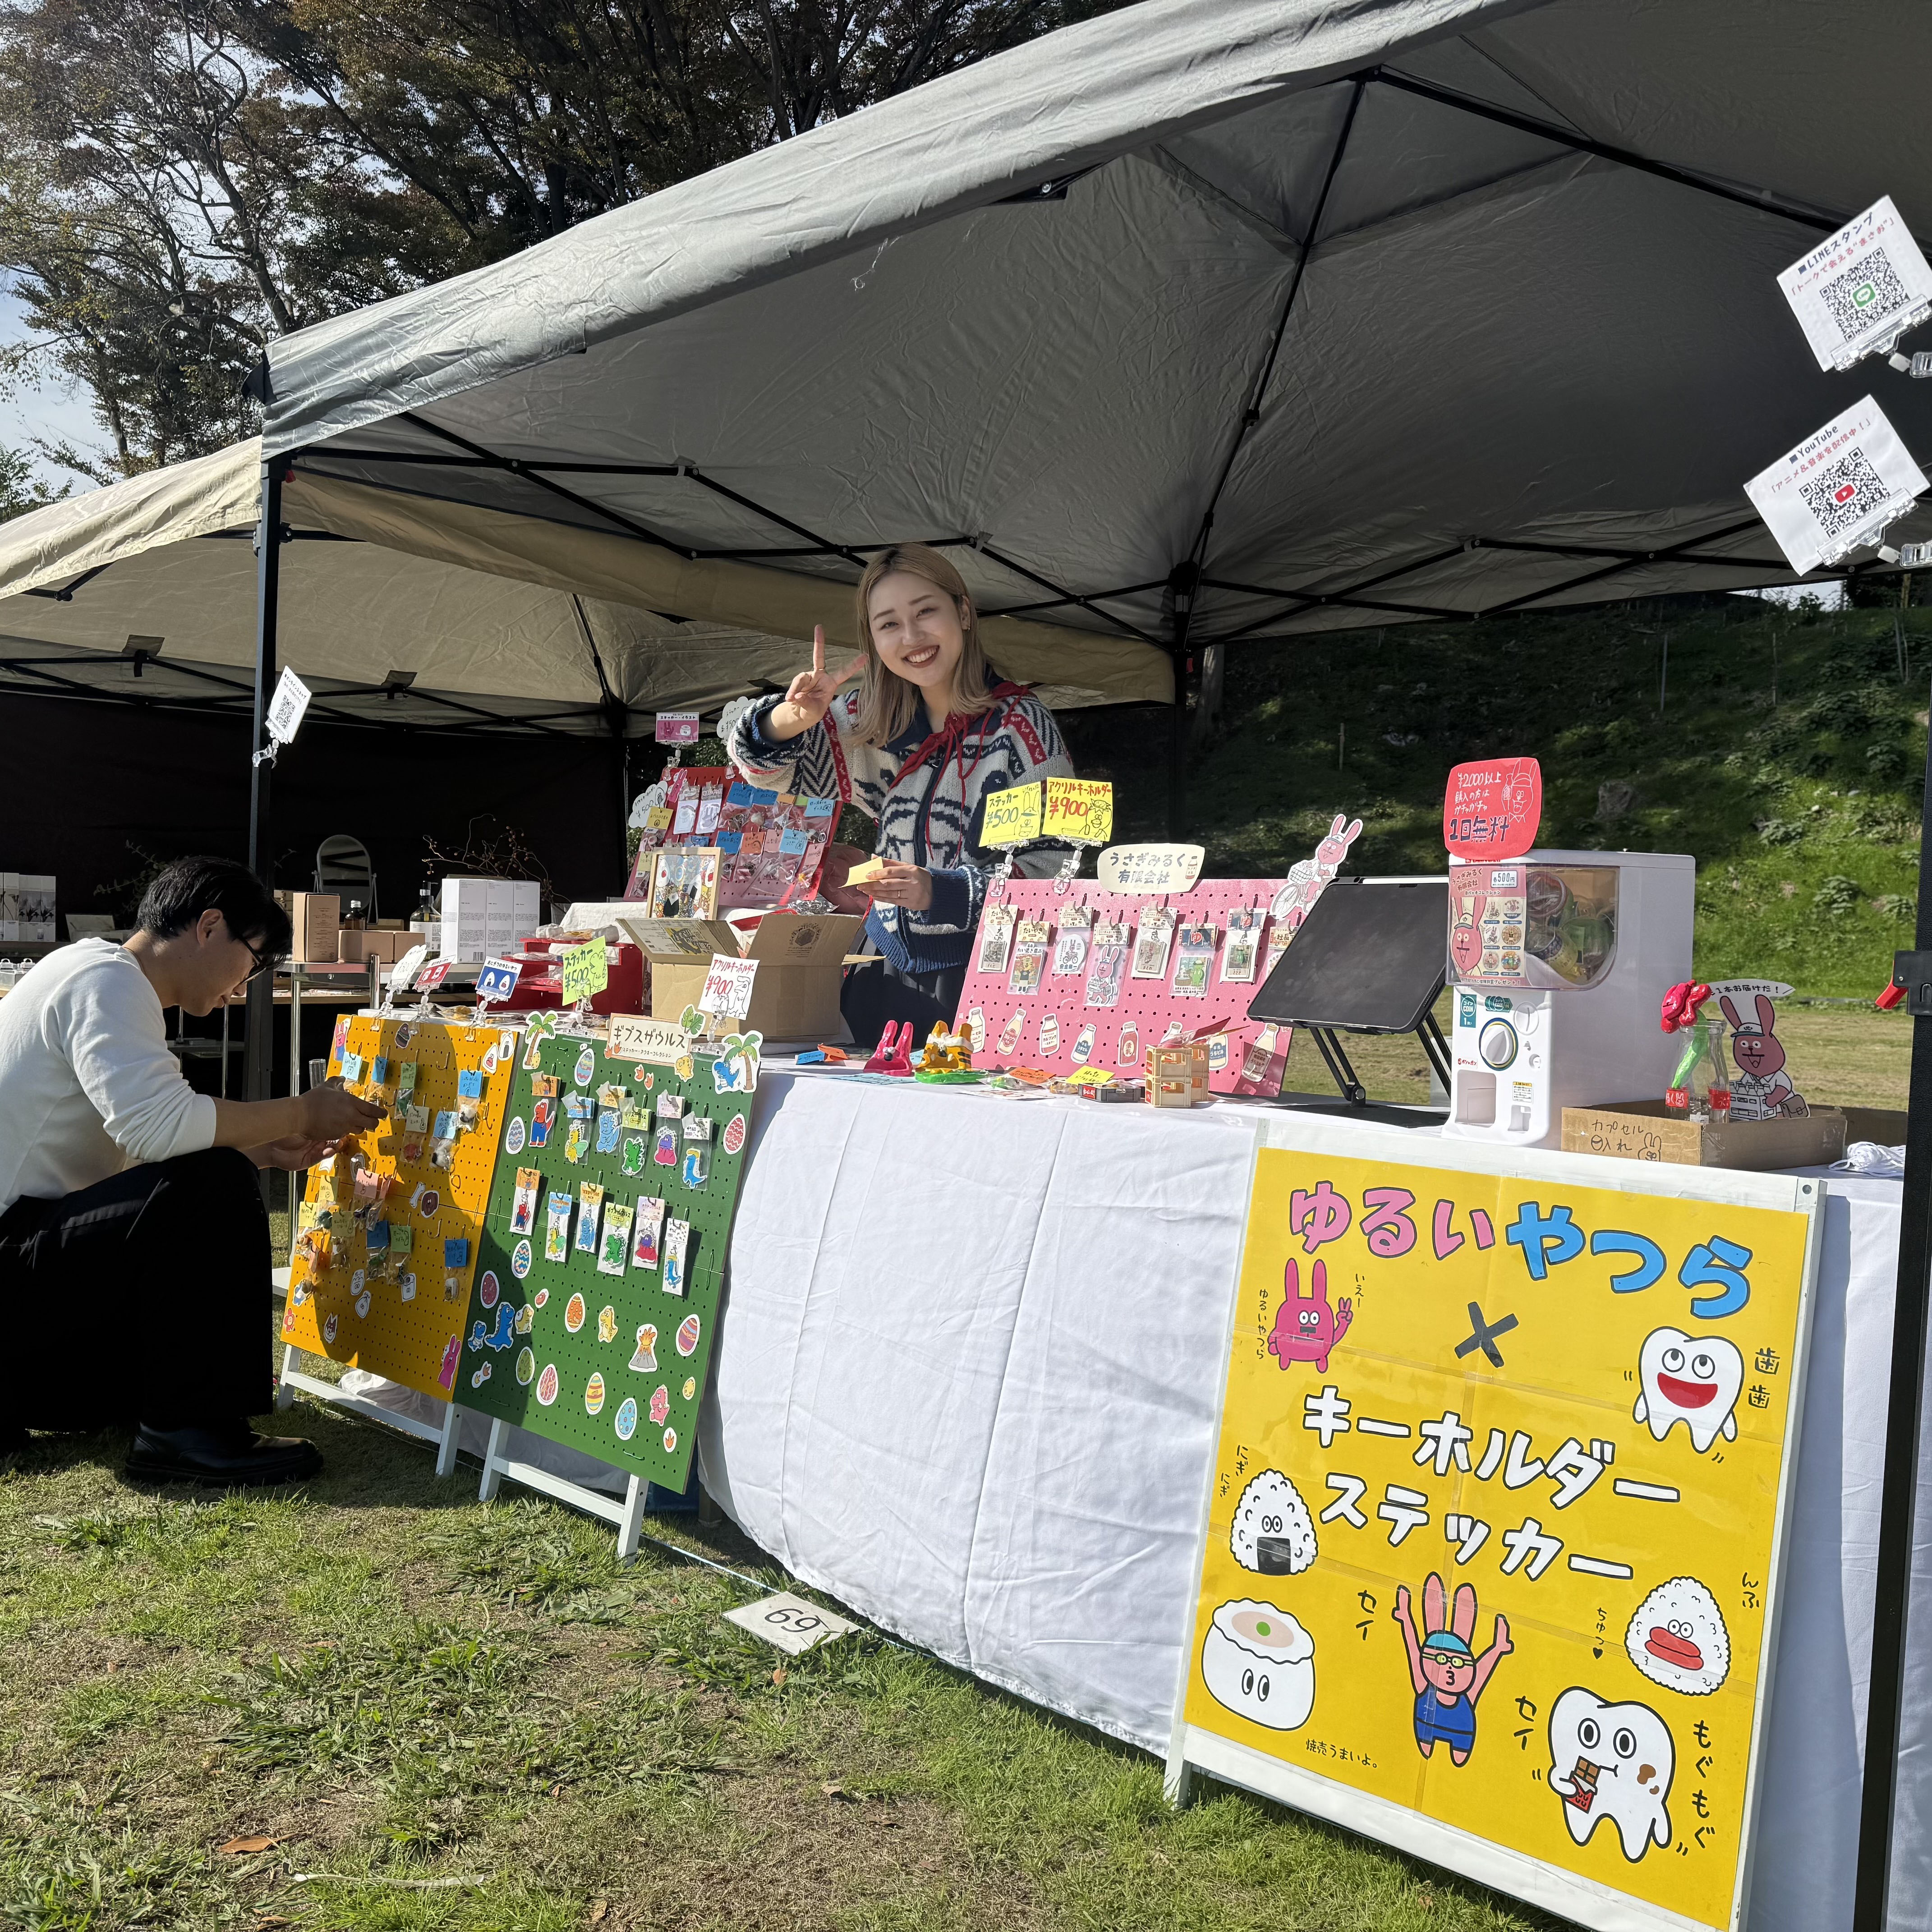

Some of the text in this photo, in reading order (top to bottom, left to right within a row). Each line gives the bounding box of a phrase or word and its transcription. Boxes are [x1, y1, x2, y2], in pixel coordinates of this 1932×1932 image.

[1798, 426, 1839, 457] YouTube
[989, 792, 1019, 808] ステッカー
[1049, 782, 1112, 797] アクリルキーホルダー
[985, 807, 1019, 829] ¥500
[1049, 796, 1088, 820] ¥900
[1454, 800, 1488, 815] ガチャガチャ
[1449, 815, 1510, 843] 1回無料
[1110, 852, 1185, 867] うさぎみるく
[1118, 869, 1170, 884] 有限会社
[1452, 867, 1483, 885] うさぎみるく
[1457, 879, 1479, 892] 有限会社
[565, 949, 593, 970] ステッカー
[565, 967, 589, 992] ¥500
[705, 975, 733, 997] ¥900
[613, 1025, 685, 1049] ギプスザウルス
[1592, 1119, 1644, 1135] カプセル
[1289, 1180, 1753, 1320] ゆるいやつら
[1355, 1274, 1365, 1308] いえー
[1256, 1288, 1269, 1360] ゆるいやつら
[1302, 1385, 1681, 1509] キーホルダー
[1319, 1472, 1635, 1581] ステッカー
[1742, 1572, 1760, 1610] んふ
[764, 1608, 821, 1633] 69
[1306, 1738, 1377, 1768] 焼売うまいよ。
[1692, 1720, 1716, 1849] もぐもぐ
